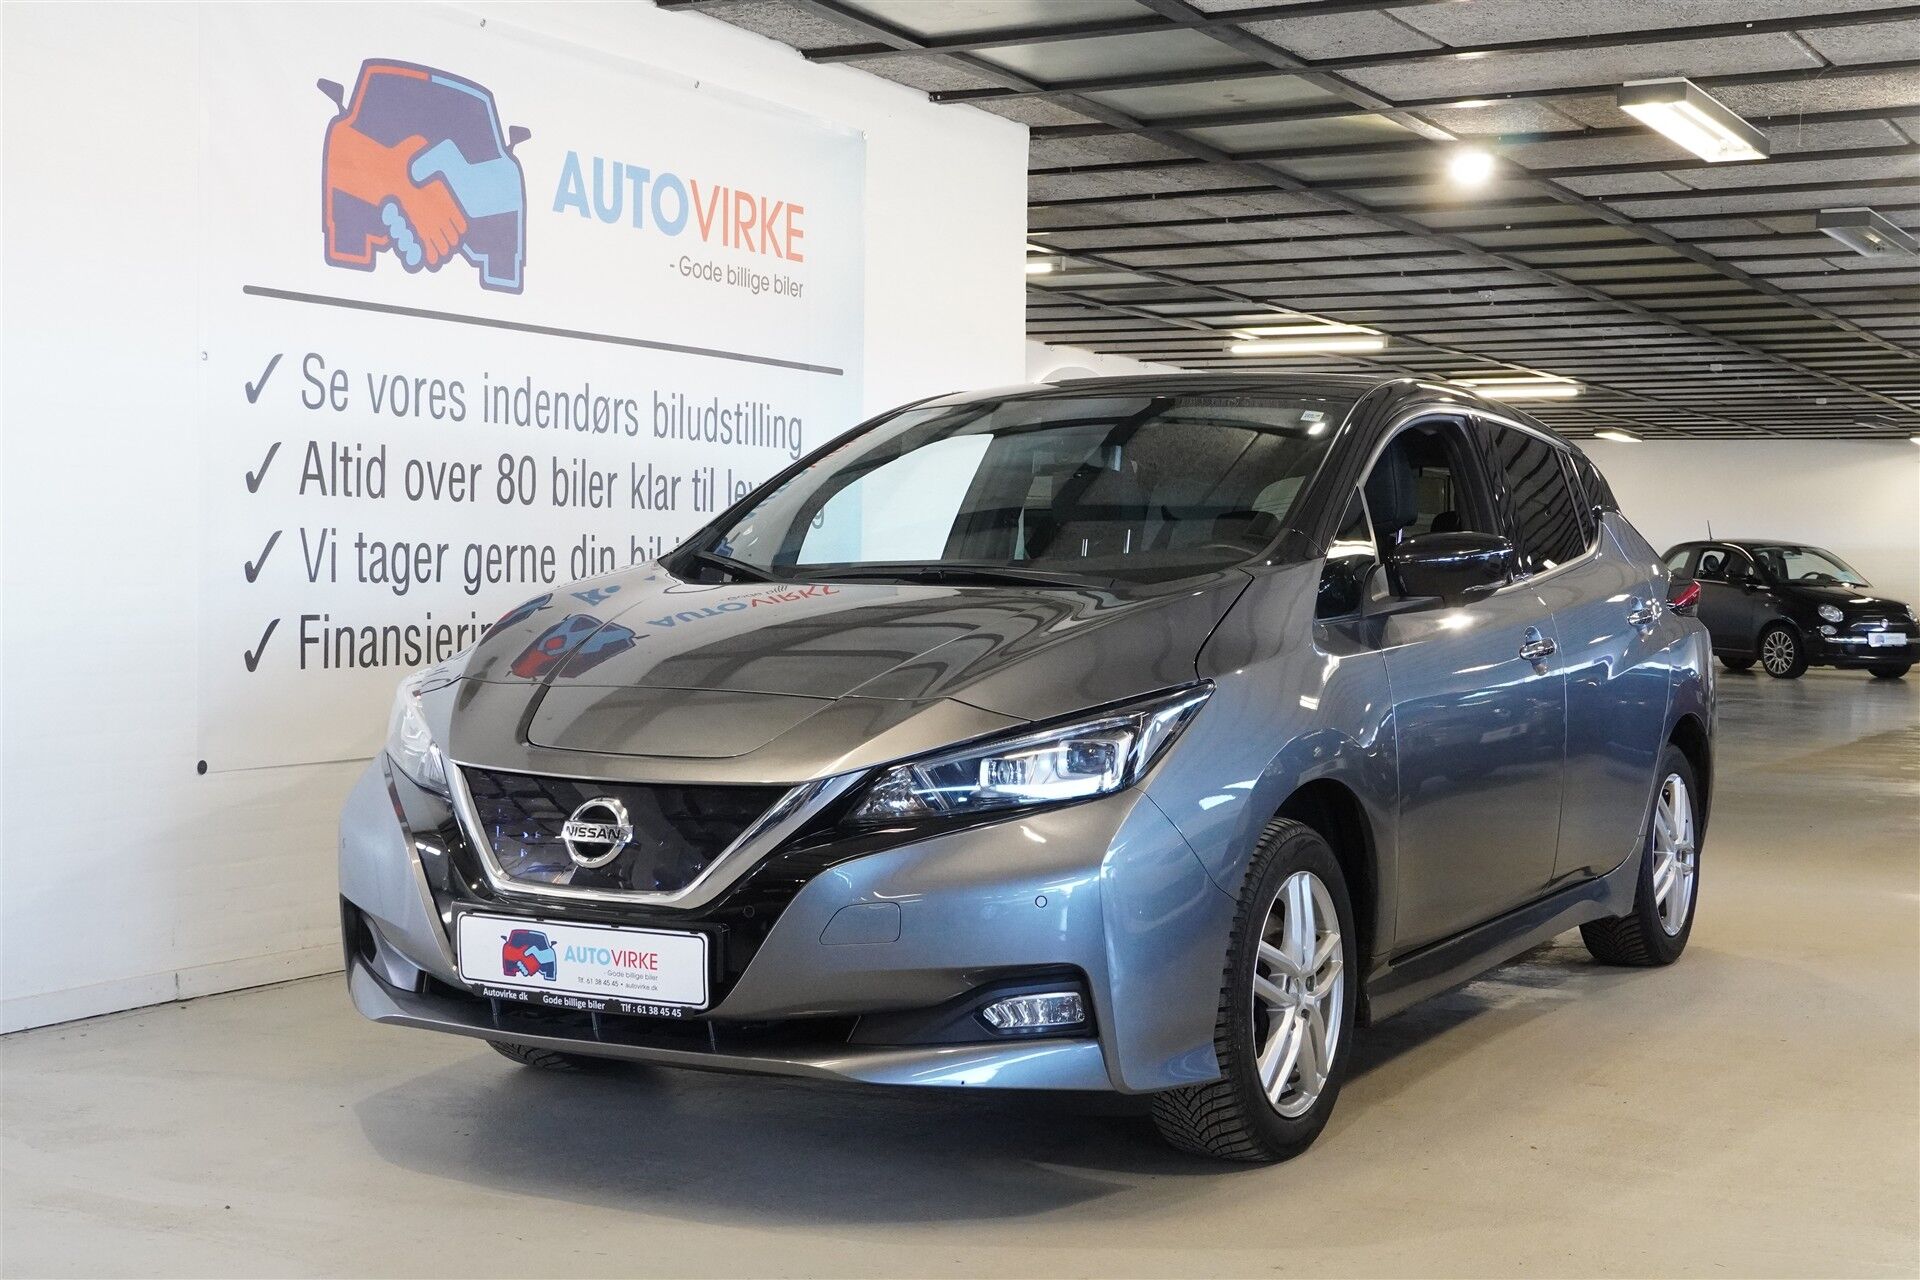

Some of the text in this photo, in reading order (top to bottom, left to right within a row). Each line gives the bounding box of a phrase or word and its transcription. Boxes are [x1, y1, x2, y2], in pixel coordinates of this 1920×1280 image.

[552, 150, 804, 263] AUTOVIRKE
[678, 255, 723, 282] Gode
[726, 264, 770, 295] billige
[773, 273, 804, 299] biler
[301, 352, 803, 460] Se vores indendørs biludstilling
[298, 439, 388, 501] Altid
[403, 457, 483, 505] over
[497, 452, 537, 507] 80
[551, 456, 619, 511] biler
[630, 461, 682, 511] klar
[692, 466, 715, 513] til
[300, 526, 338, 583] Vi
[354, 531, 449, 596] tager
[463, 540, 556, 596] gerne
[570, 533, 616, 581] din
[566, 825, 621, 840] NISSAN
[564, 945, 658, 971] AUTOVIRKE
[603, 979, 611, 987] 45
[611, 980, 619, 988] 45
[607, 970, 624, 978] Gode
[482, 986, 529, 1001] Autovirke dk
[542, 994, 606, 1011] Gode billige biler
[636, 1005, 648, 1015] 61
[648, 1006, 659, 1016] 38
[659, 1007, 671, 1017] 45
[671, 1008, 683, 1018] 45
